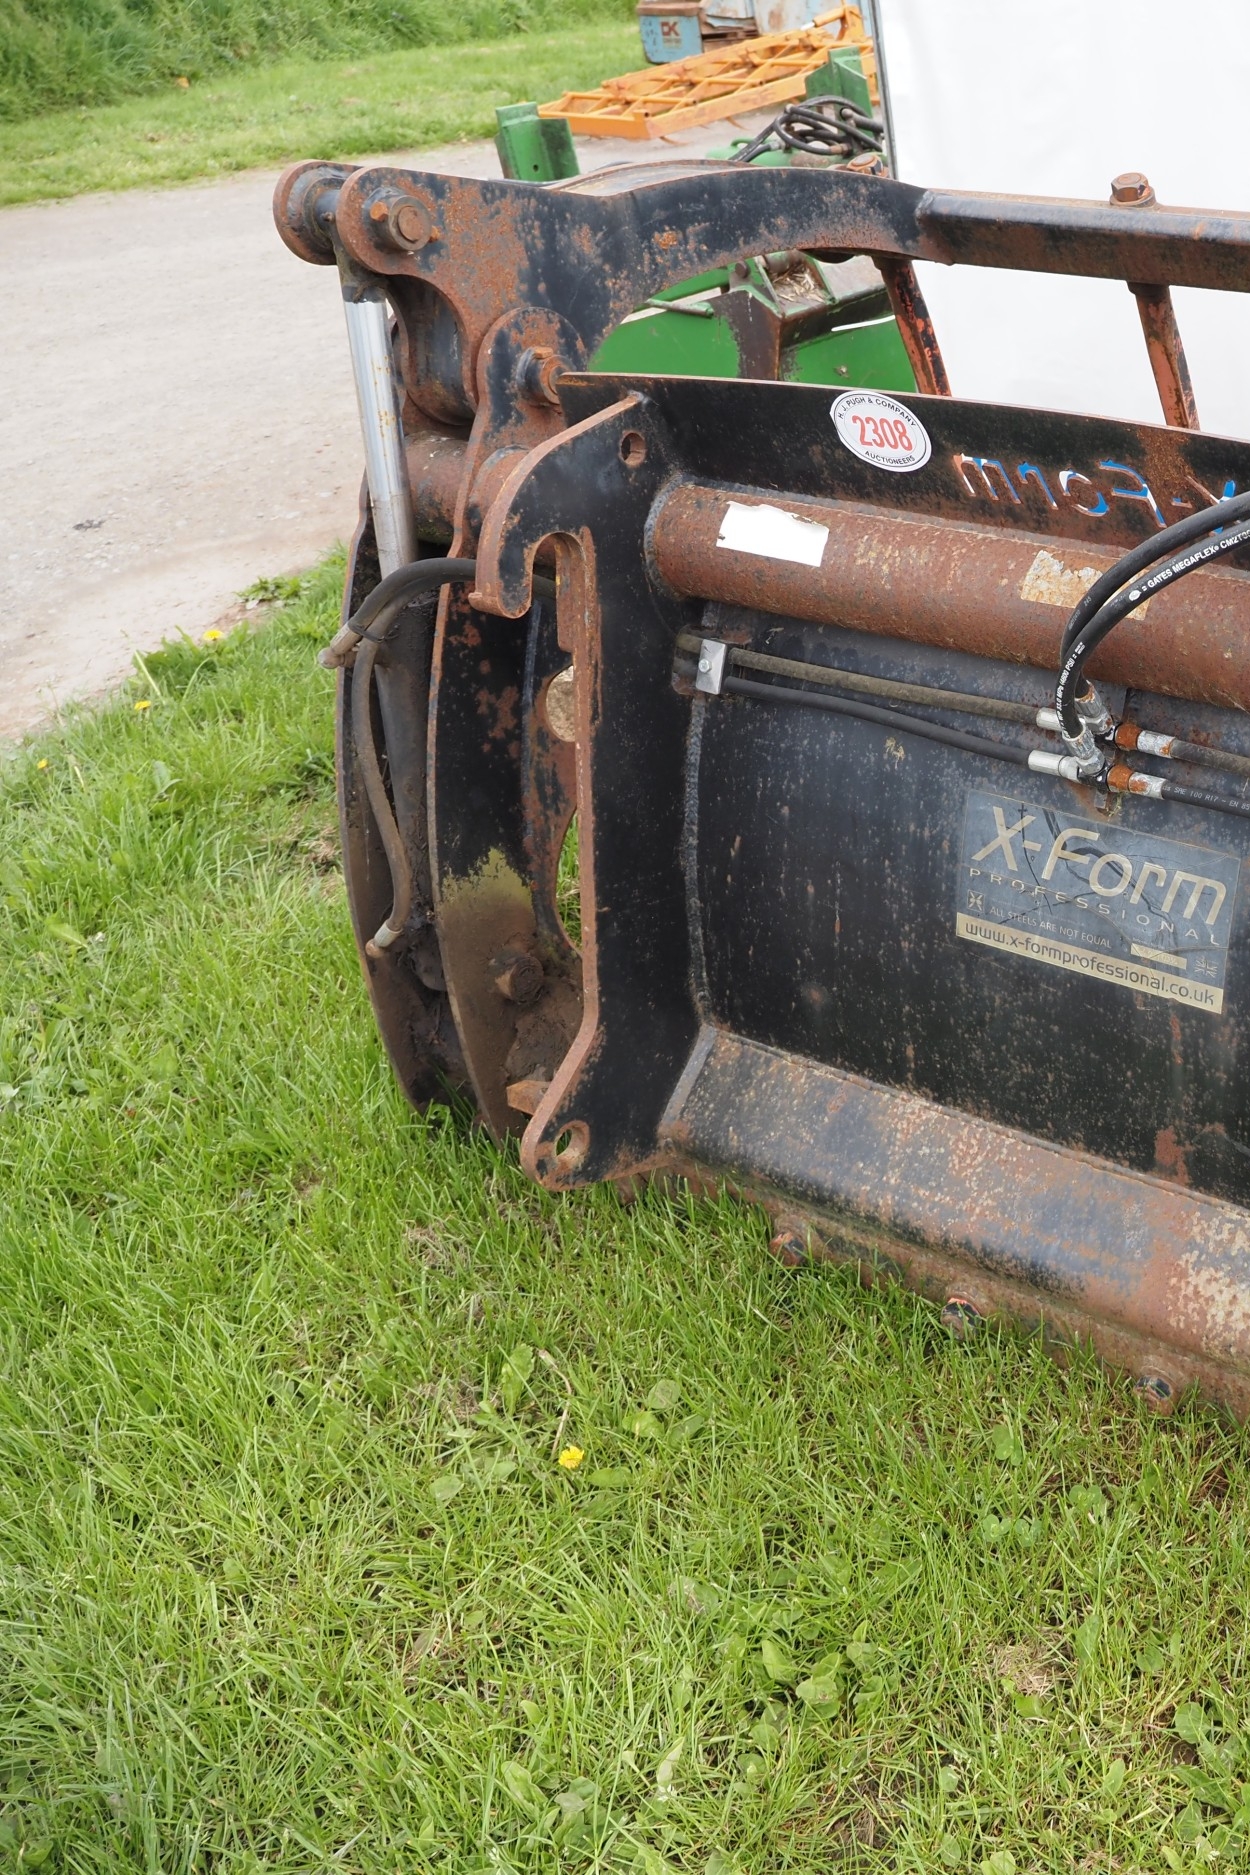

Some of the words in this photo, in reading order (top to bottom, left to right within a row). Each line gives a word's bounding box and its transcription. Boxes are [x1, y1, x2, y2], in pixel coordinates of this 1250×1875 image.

[847, 396, 866, 407] PUGH
[875, 398, 916, 427] COMPANY
[852, 415, 913, 452] 2308
[864, 450, 916, 465] AUCTIONEERS
[1148, 570, 1173, 588] GATES
[1173, 786, 1187, 795] SAE
[1189, 790, 1202, 799] 100
[1205, 793, 1218, 803] R17
[1229, 800, 1239, 808] EN
[970, 805, 1227, 925] X-Form
[969, 867, 1220, 946] PROFESSIONAL
[989, 906, 1005, 918] ALL
[1008, 912, 1037, 926] STEELS
[1039, 919, 1057, 933] ARE
[1059, 926, 1079, 938] NOT
[1081, 932, 1113, 949] EQUAL
[965, 921, 1216, 1006] www.x-formprofessional.co.uk
